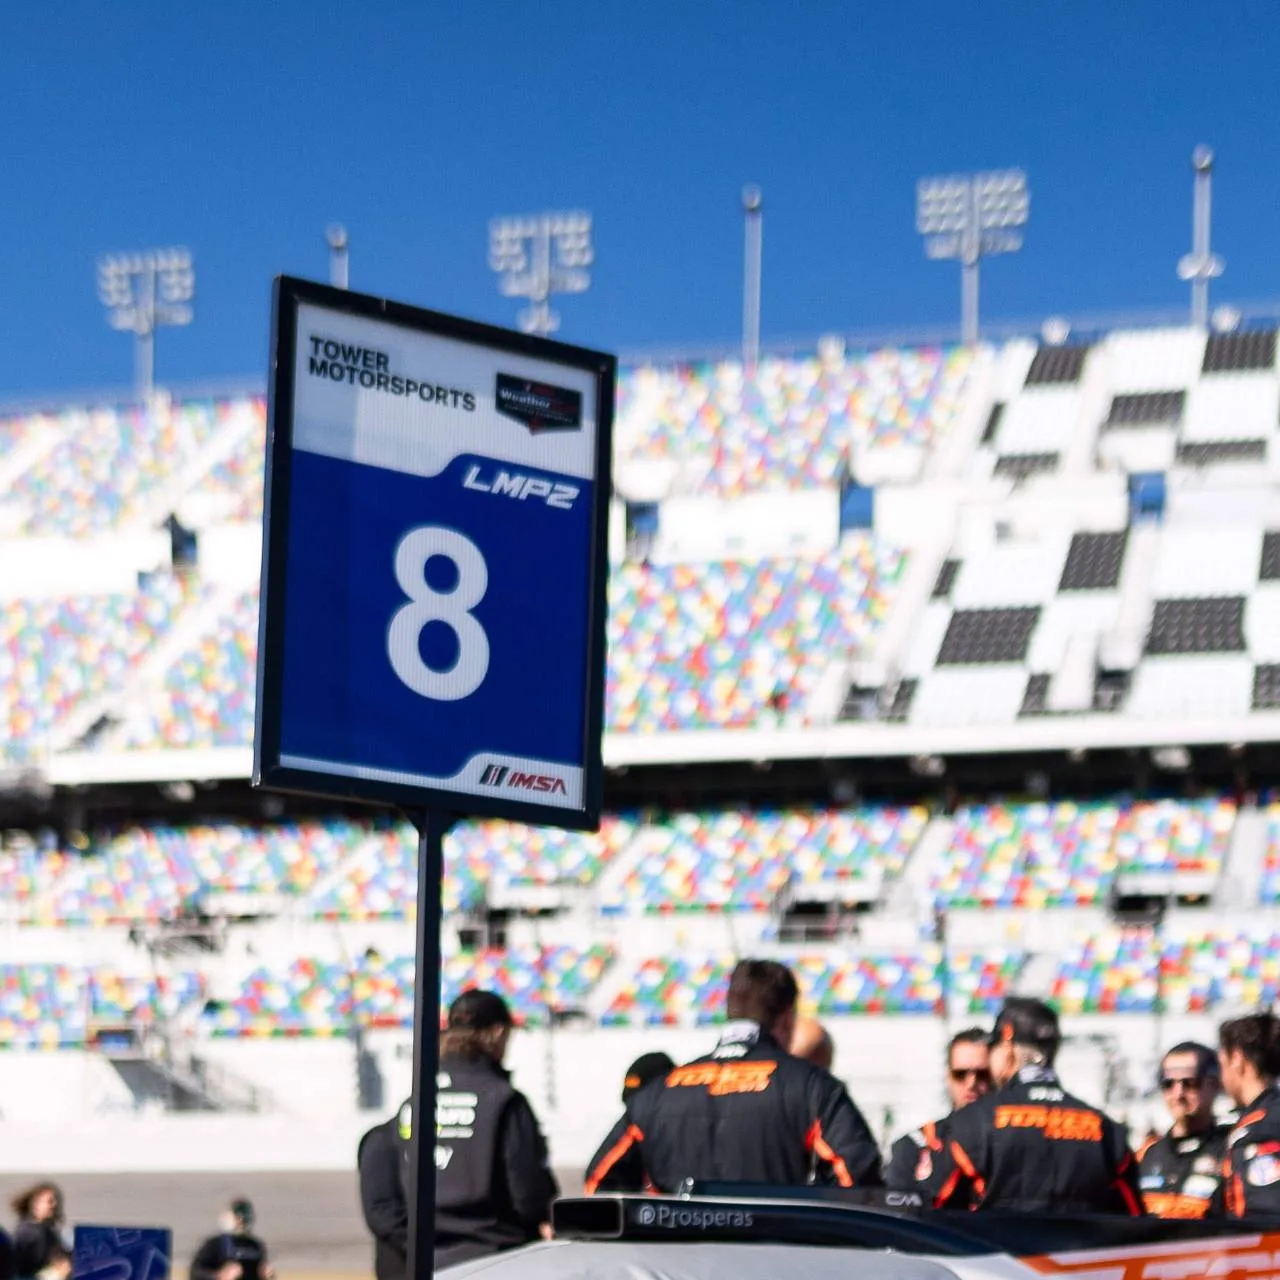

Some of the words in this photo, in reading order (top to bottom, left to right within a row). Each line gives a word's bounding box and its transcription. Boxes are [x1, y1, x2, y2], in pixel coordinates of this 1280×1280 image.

[309, 336, 390, 373] TOWER
[308, 356, 476, 413] MOTORSPORTS
[463, 465, 581, 510] LMP2
[387, 526, 490, 701] 8
[507, 771, 569, 796] IMSA
[658, 1206, 754, 1229] Prosperas
